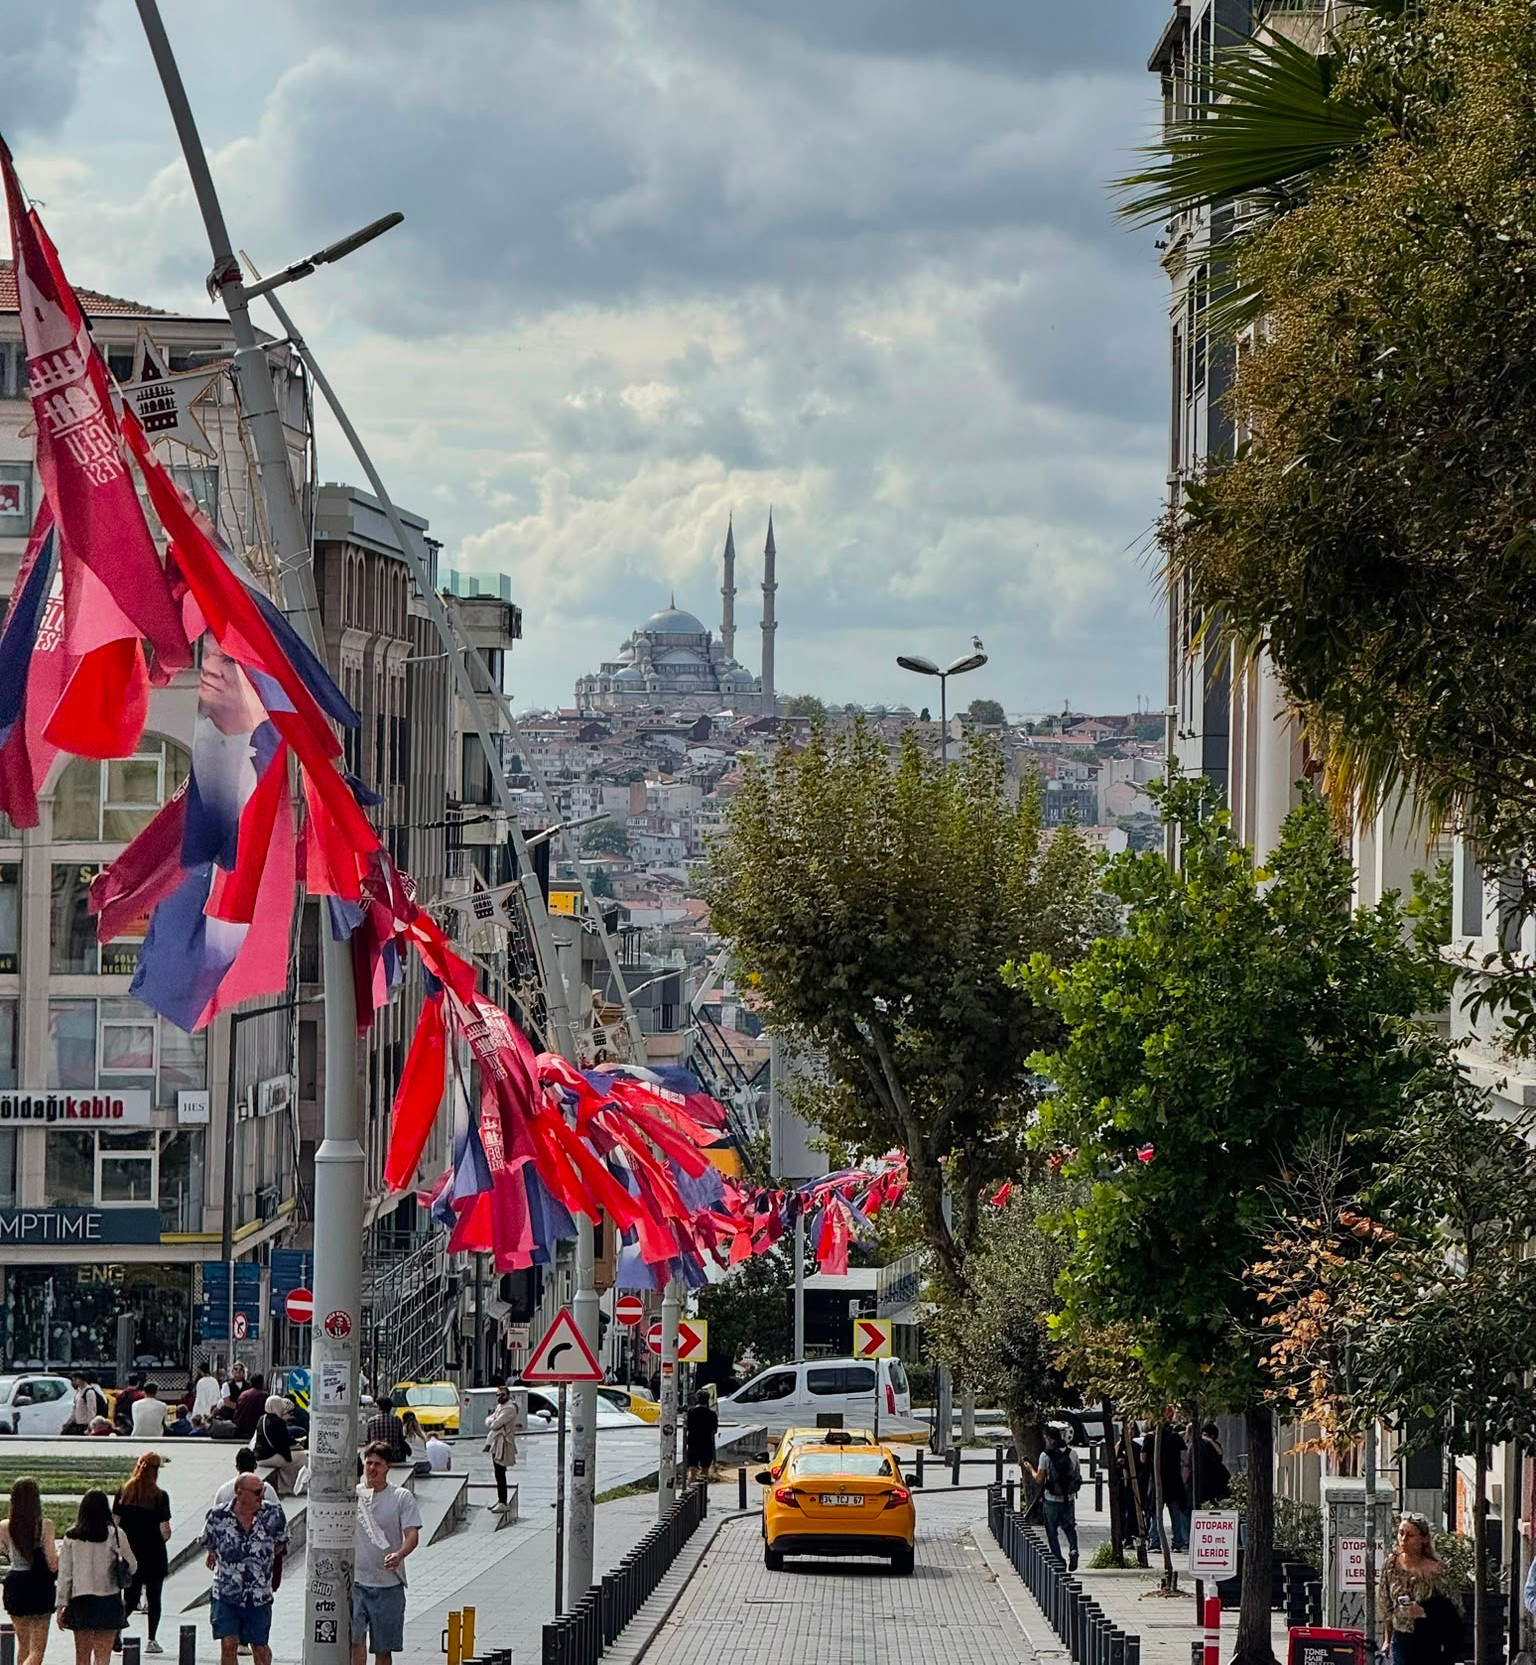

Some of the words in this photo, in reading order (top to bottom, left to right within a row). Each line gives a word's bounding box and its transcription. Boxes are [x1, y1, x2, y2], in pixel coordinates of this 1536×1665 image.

[183, 1102, 205, 1112] HES
[0, 1213, 103, 1239] MPTIME
[824, 1496, 832, 1504] 34
[1195, 1521, 1234, 1530] OTOPARK
[1202, 1534, 1213, 1544] 50
[1342, 1541, 1383, 1550] OTOPK
[1350, 1555, 1361, 1564] 50
